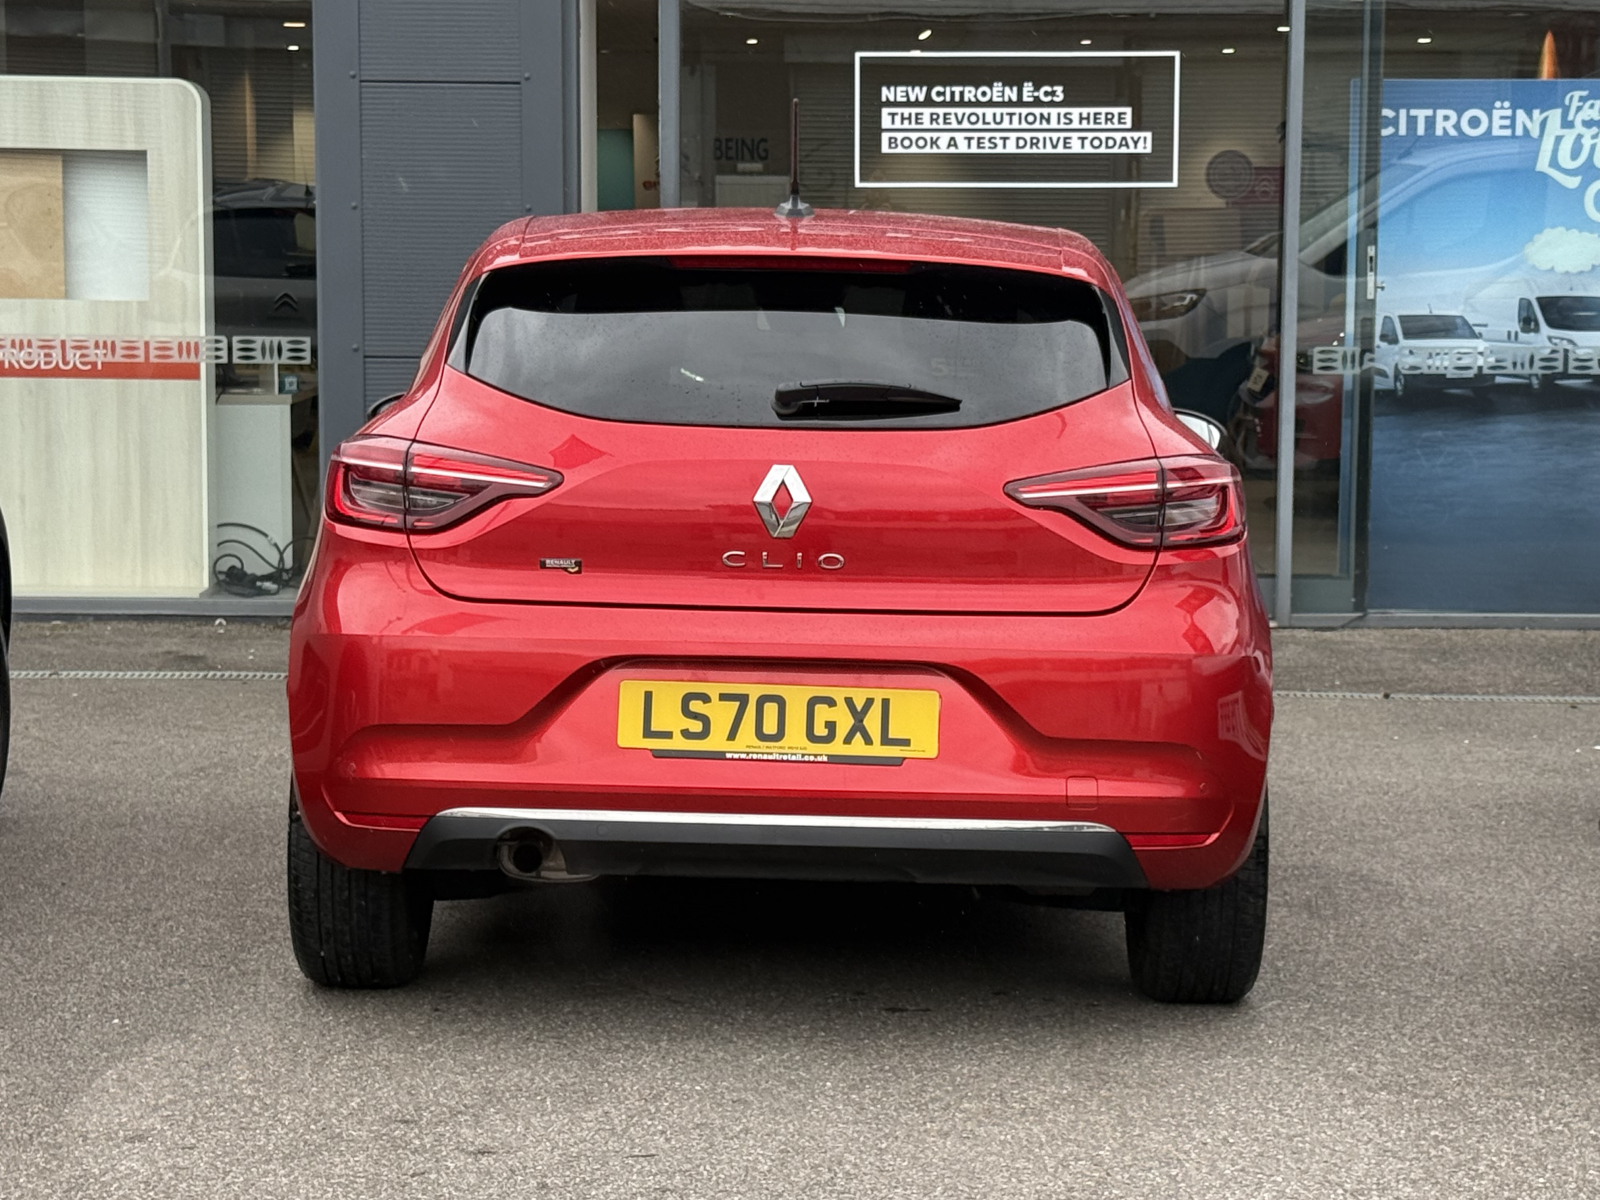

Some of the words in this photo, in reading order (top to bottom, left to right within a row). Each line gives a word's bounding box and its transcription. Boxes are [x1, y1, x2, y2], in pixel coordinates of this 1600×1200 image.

[881, 86, 927, 102] NEW
[930, 82, 1018, 102] CITROËN
[1022, 82, 1064, 102] Ë-C3
[887, 112, 924, 126] THE
[929, 112, 1051, 126] REVOLUTION
[1057, 112, 1074, 126] IS
[1078, 112, 1128, 126] HERE
[1380, 101, 1541, 137] CITROËN
[713, 137, 769, 161] BEING
[887, 136, 941, 150] BOOK
[946, 136, 959, 150] A
[963, 136, 1011, 150] TEST
[1015, 136, 1073, 150] DRIVE
[1077, 136, 1148, 150] TODAY!
[545, 558, 576, 566] RENAULT
[722, 550, 845, 570] CLIO
[642, 690, 786, 743] LS70
[805, 695, 912, 747] GXL
[725, 752, 828, 762] www.renaultretail.co.uk
